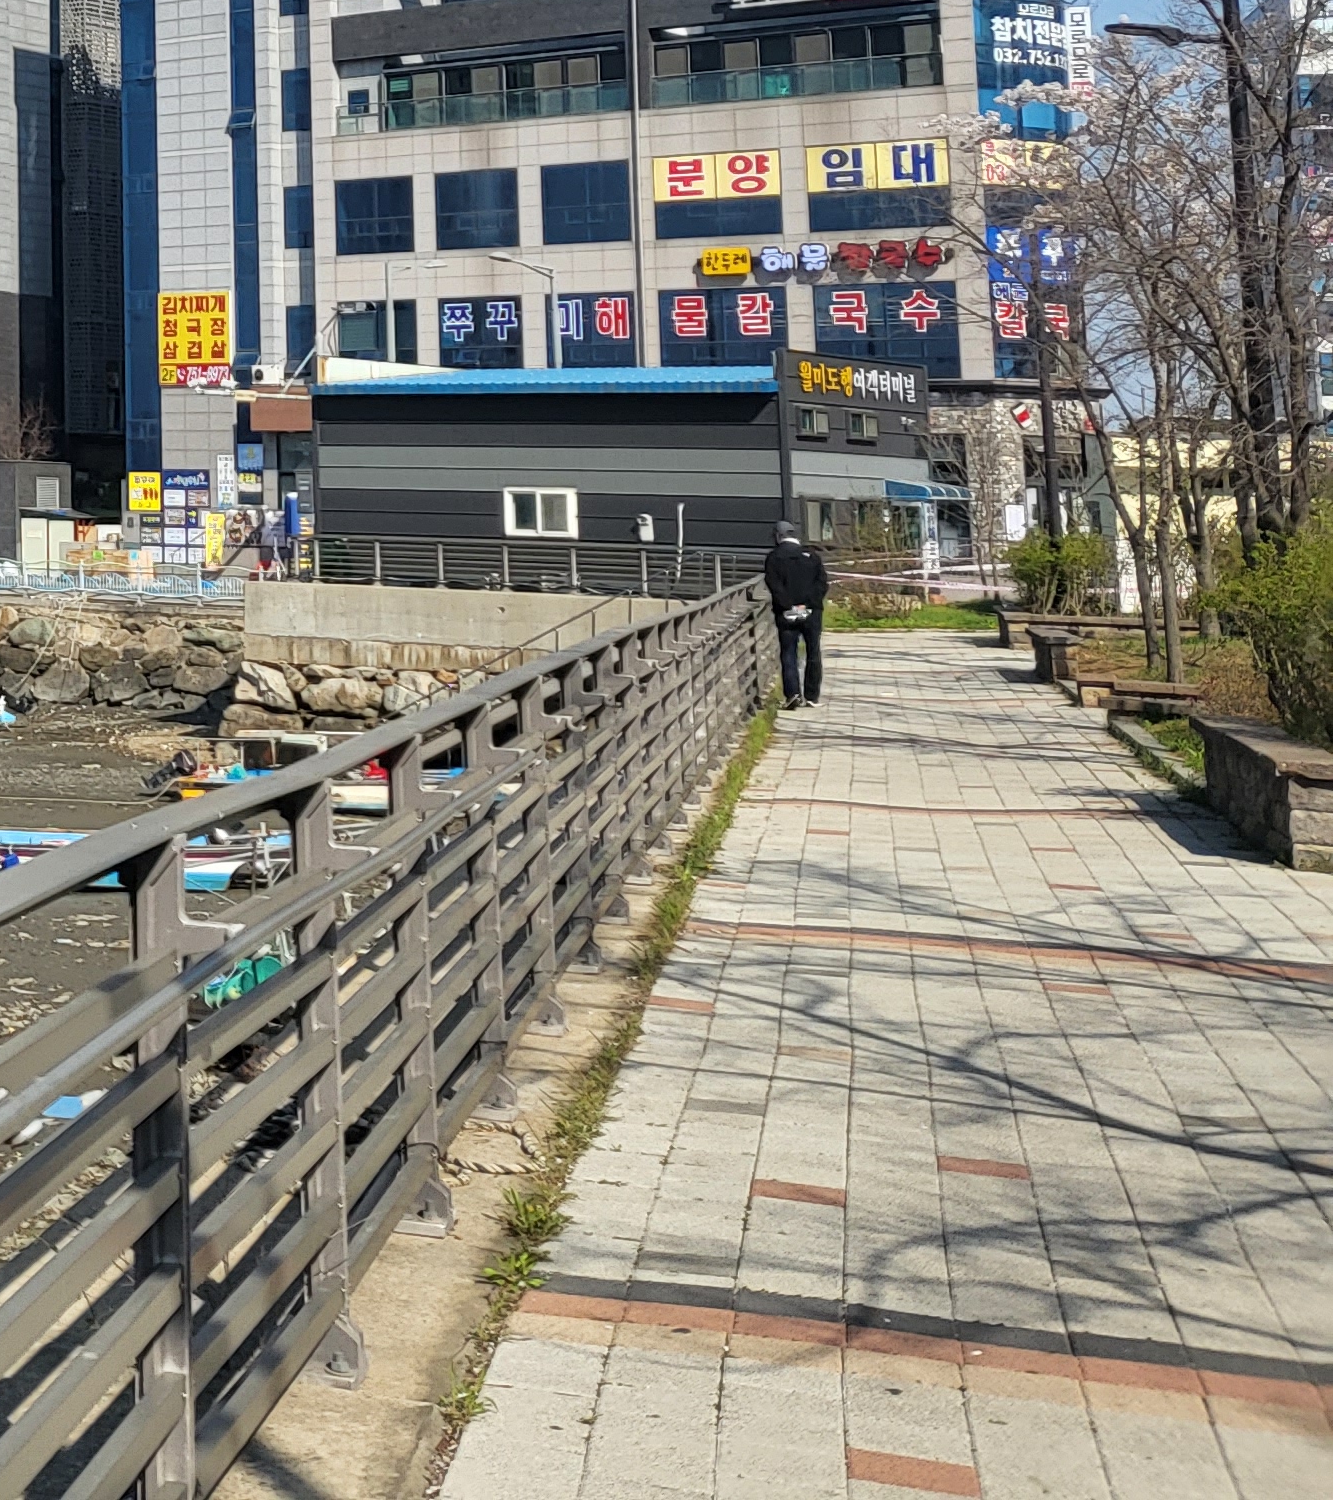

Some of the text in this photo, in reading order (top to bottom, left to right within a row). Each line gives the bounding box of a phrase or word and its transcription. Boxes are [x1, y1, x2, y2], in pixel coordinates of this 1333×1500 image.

[990, 15, 1066, 48] 참치전문
[1069, 11, 1091, 79] 모로모로
[666, 153, 770, 198] 분양
[821, 142, 937, 188] 임대
[705, 251, 748, 273] 한두레
[161, 294, 226, 316] 김치찌개
[162, 317, 227, 338] 청국장
[162, 339, 227, 360] 삼겹살
[161, 367, 175, 382] 2F
[798, 360, 917, 404] 월미도행 여객터미널
